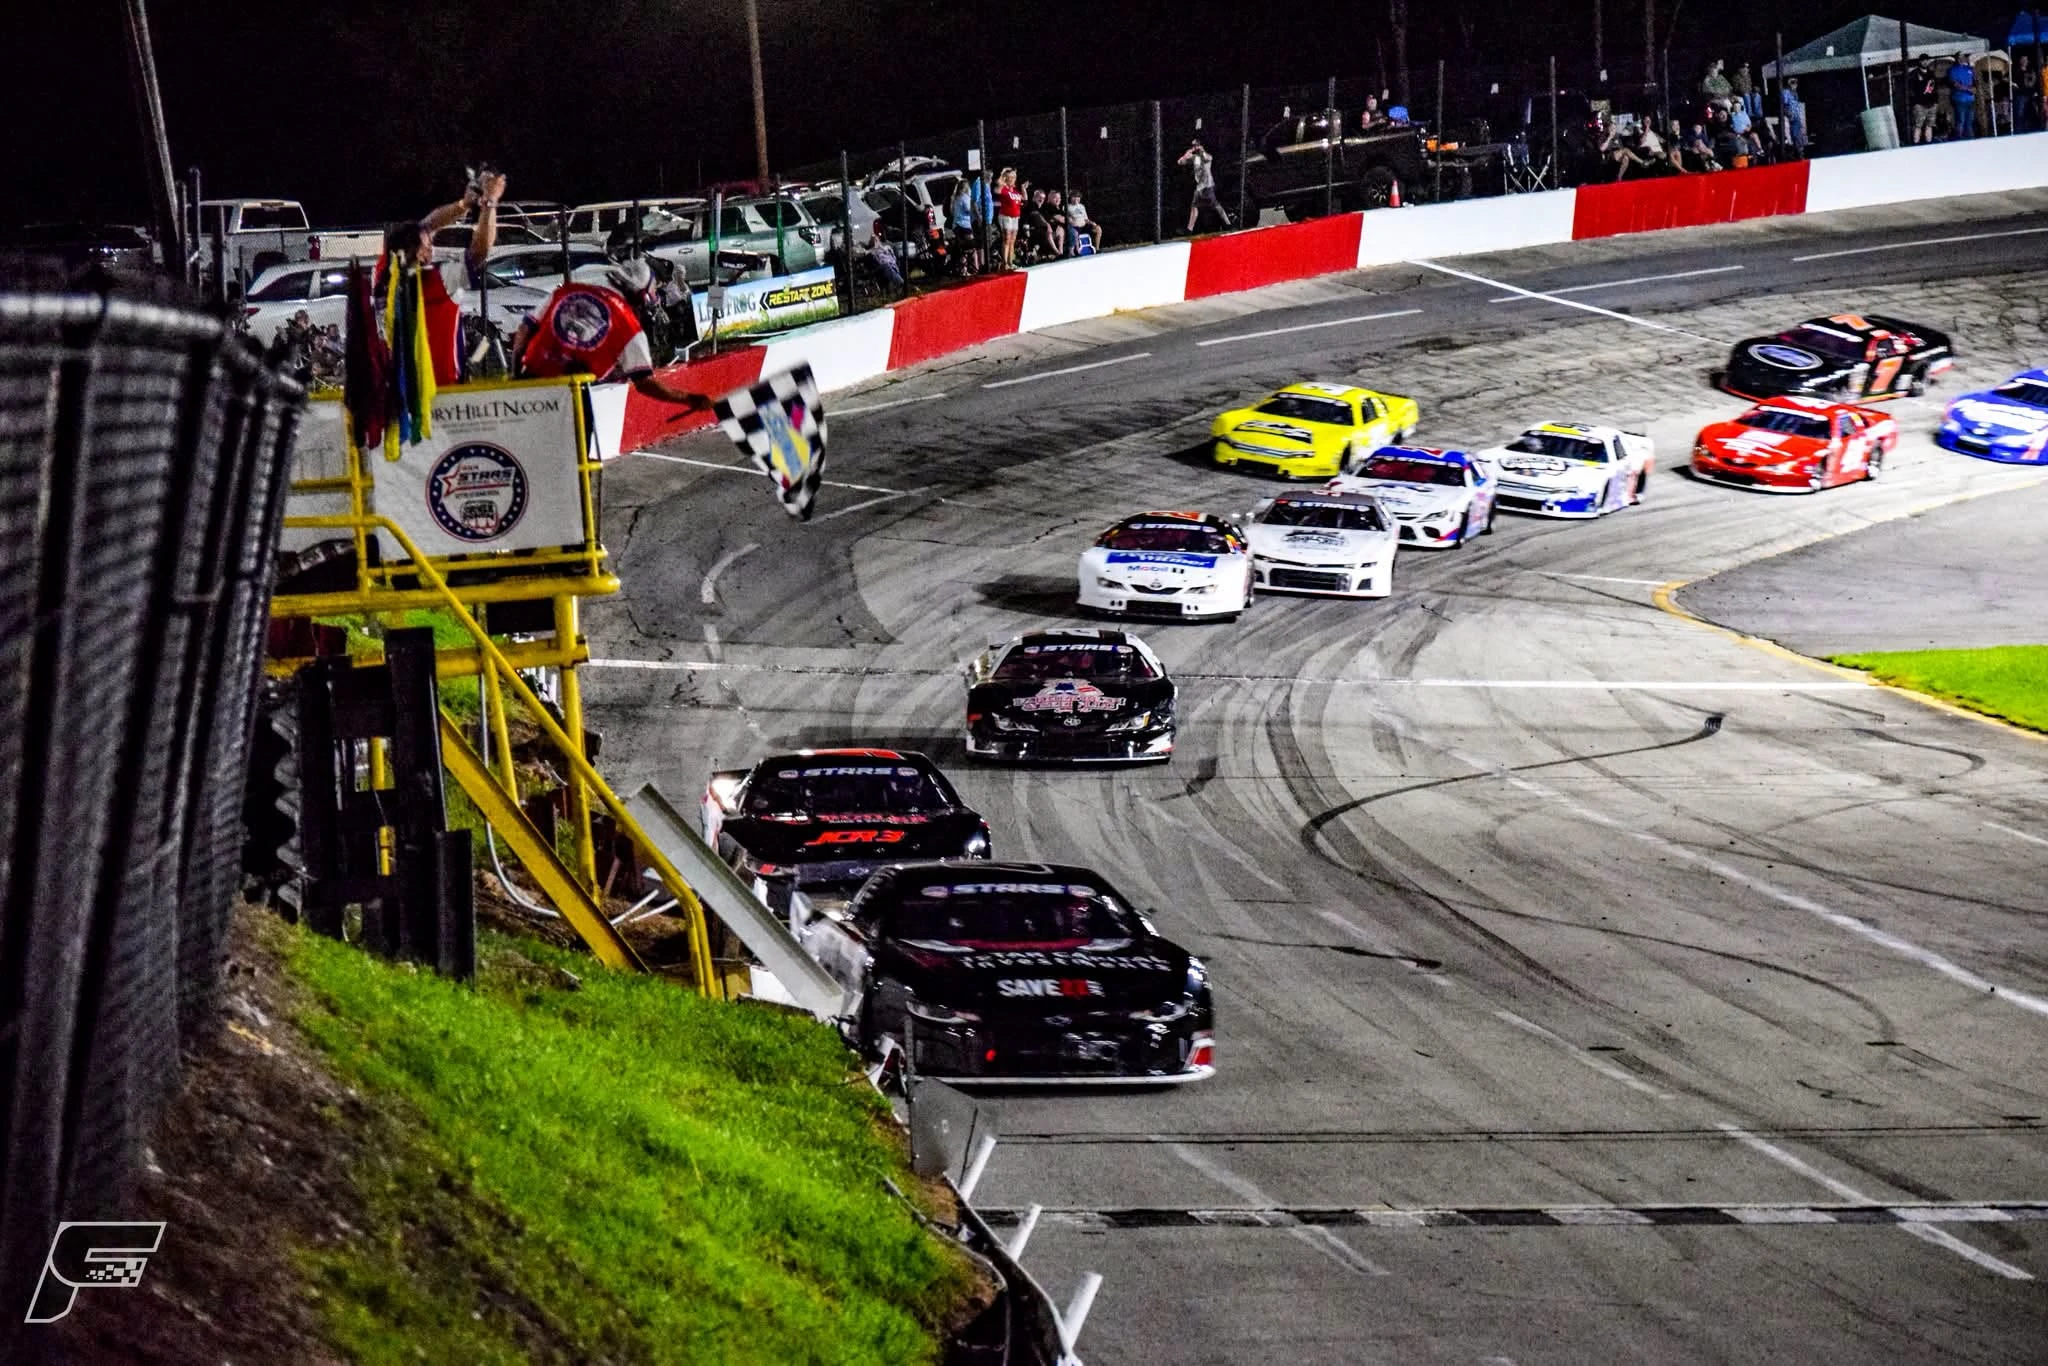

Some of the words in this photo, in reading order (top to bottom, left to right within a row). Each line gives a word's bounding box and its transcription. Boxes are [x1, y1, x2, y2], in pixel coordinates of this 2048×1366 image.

[769, 288, 810, 306] RESTART
[811, 283, 833, 298] ZONE
[458, 468, 513, 481] STARS
[1043, 644, 1113, 652] STARS
[803, 767, 893, 777] STARS
[952, 883, 1065, 894] STARS
